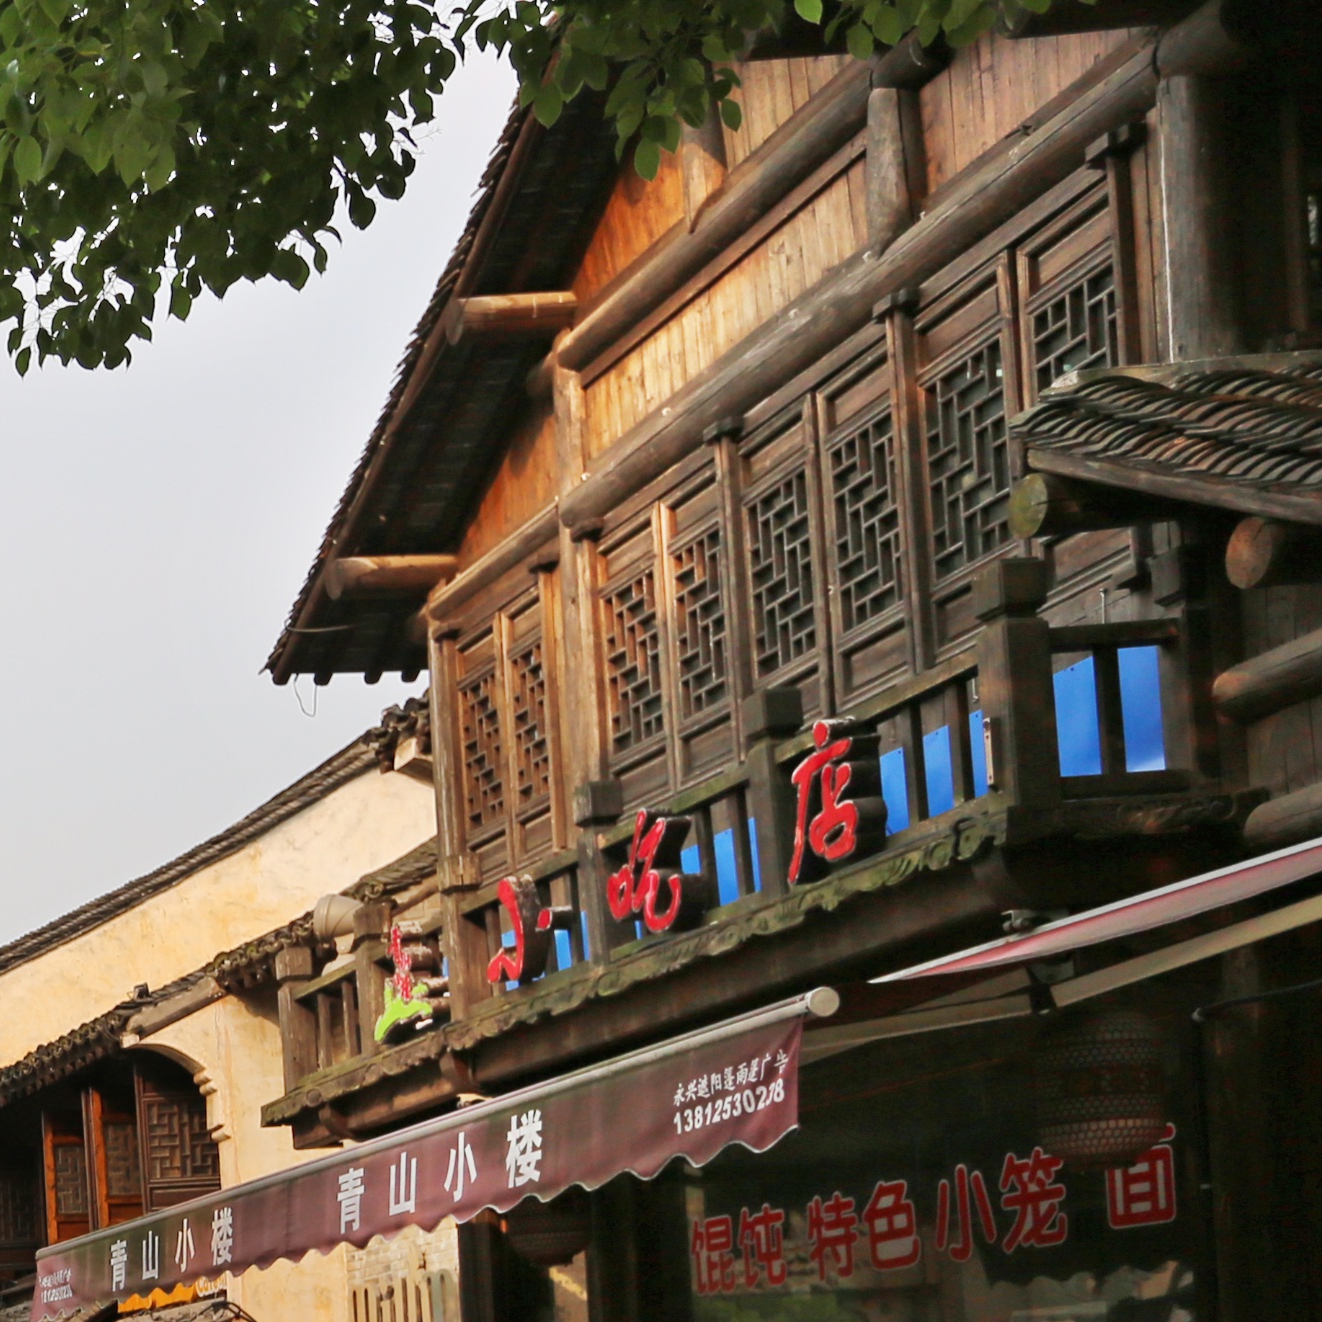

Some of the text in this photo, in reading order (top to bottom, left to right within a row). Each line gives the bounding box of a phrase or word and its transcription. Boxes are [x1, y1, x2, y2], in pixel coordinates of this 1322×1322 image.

[337, 1111, 544, 1235] 青山小楼
[109, 1208, 234, 1292] 青山小楼
